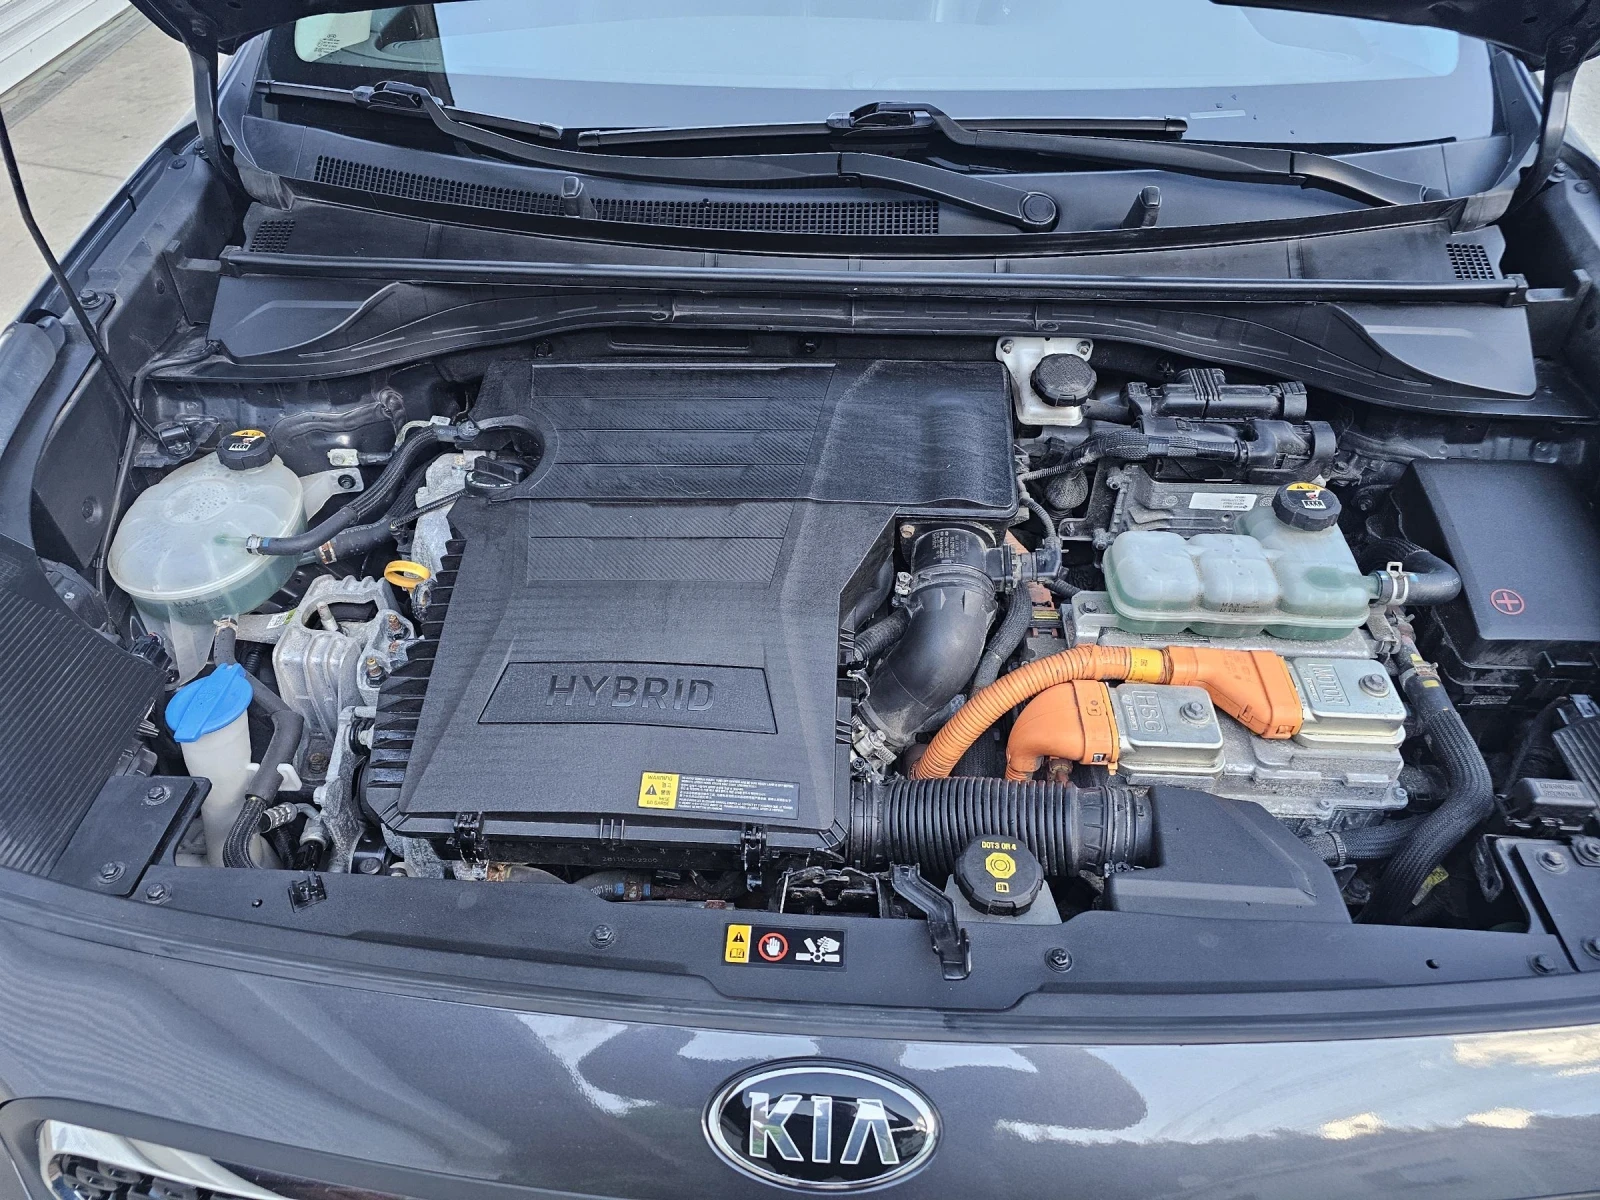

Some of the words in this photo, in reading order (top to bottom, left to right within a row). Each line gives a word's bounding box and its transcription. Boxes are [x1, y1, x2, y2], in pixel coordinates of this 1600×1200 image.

[546, 674, 715, 711] HYBRID
[1312, 666, 1346, 705] MOTOR
[1136, 695, 1164, 732] HSG
[647, 774, 673, 782] WARNING
[748, 1091, 900, 1165] KIA
